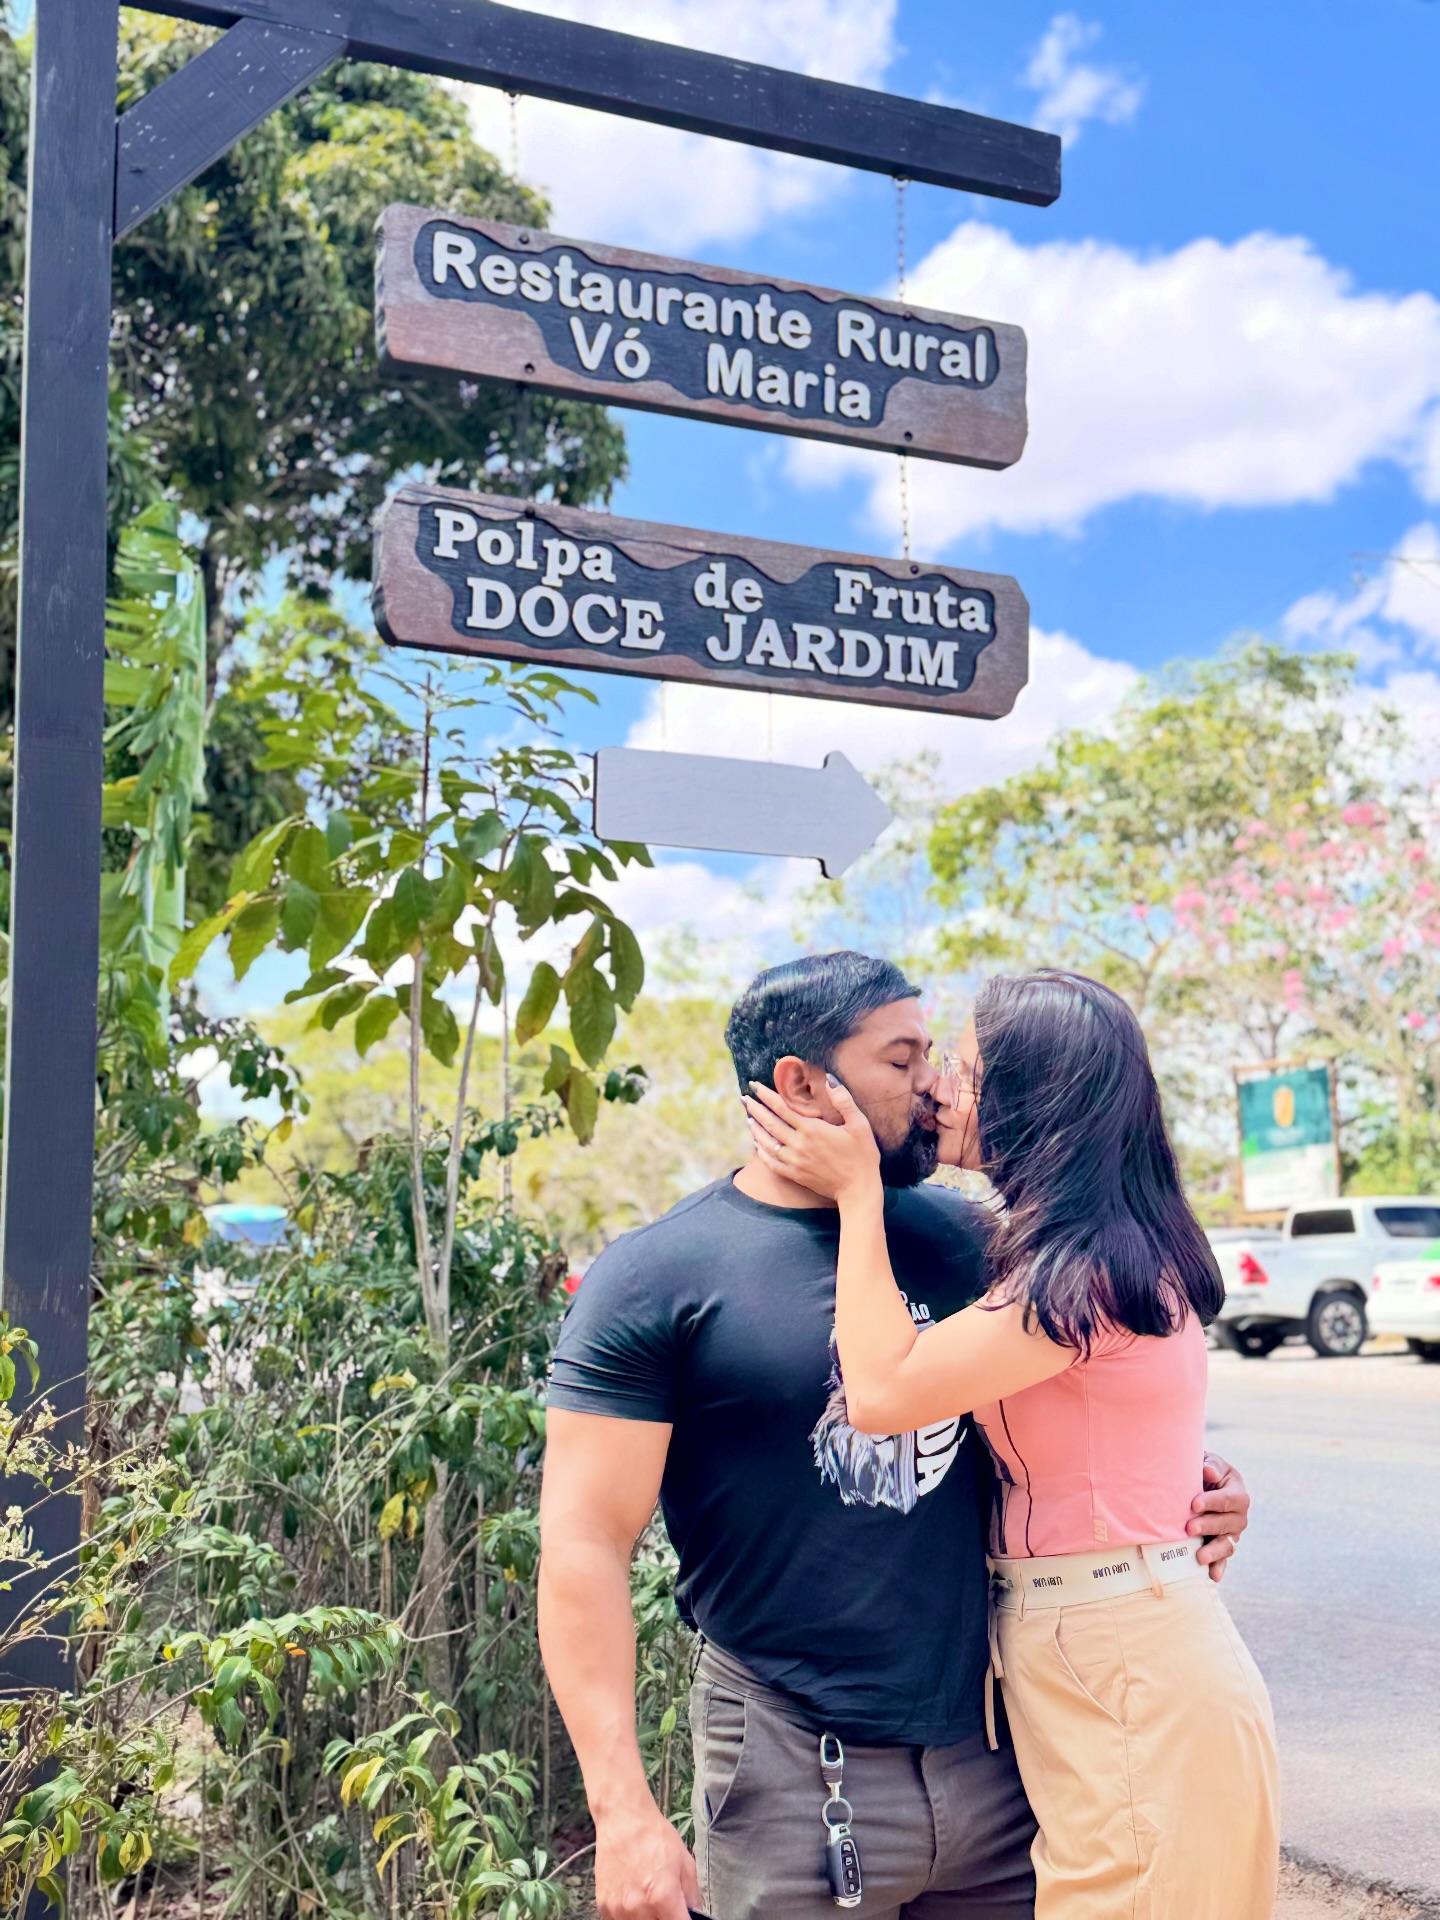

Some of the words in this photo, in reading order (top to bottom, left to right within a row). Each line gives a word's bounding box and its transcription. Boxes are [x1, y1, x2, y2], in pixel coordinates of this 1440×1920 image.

[431, 230, 813, 351] Restaurante
[837, 310, 988, 383] Rural
[569, 316, 651, 379] Vó
[706, 343, 872, 421] Maria
[432, 508, 617, 588] Polpa
[694, 562, 764, 612] de
[834, 568, 991, 634] Fruta
[466, 576, 666, 651] DOCE
[706, 613, 960, 689] JARDIM
[909, 1302, 931, 1321] ÃO
